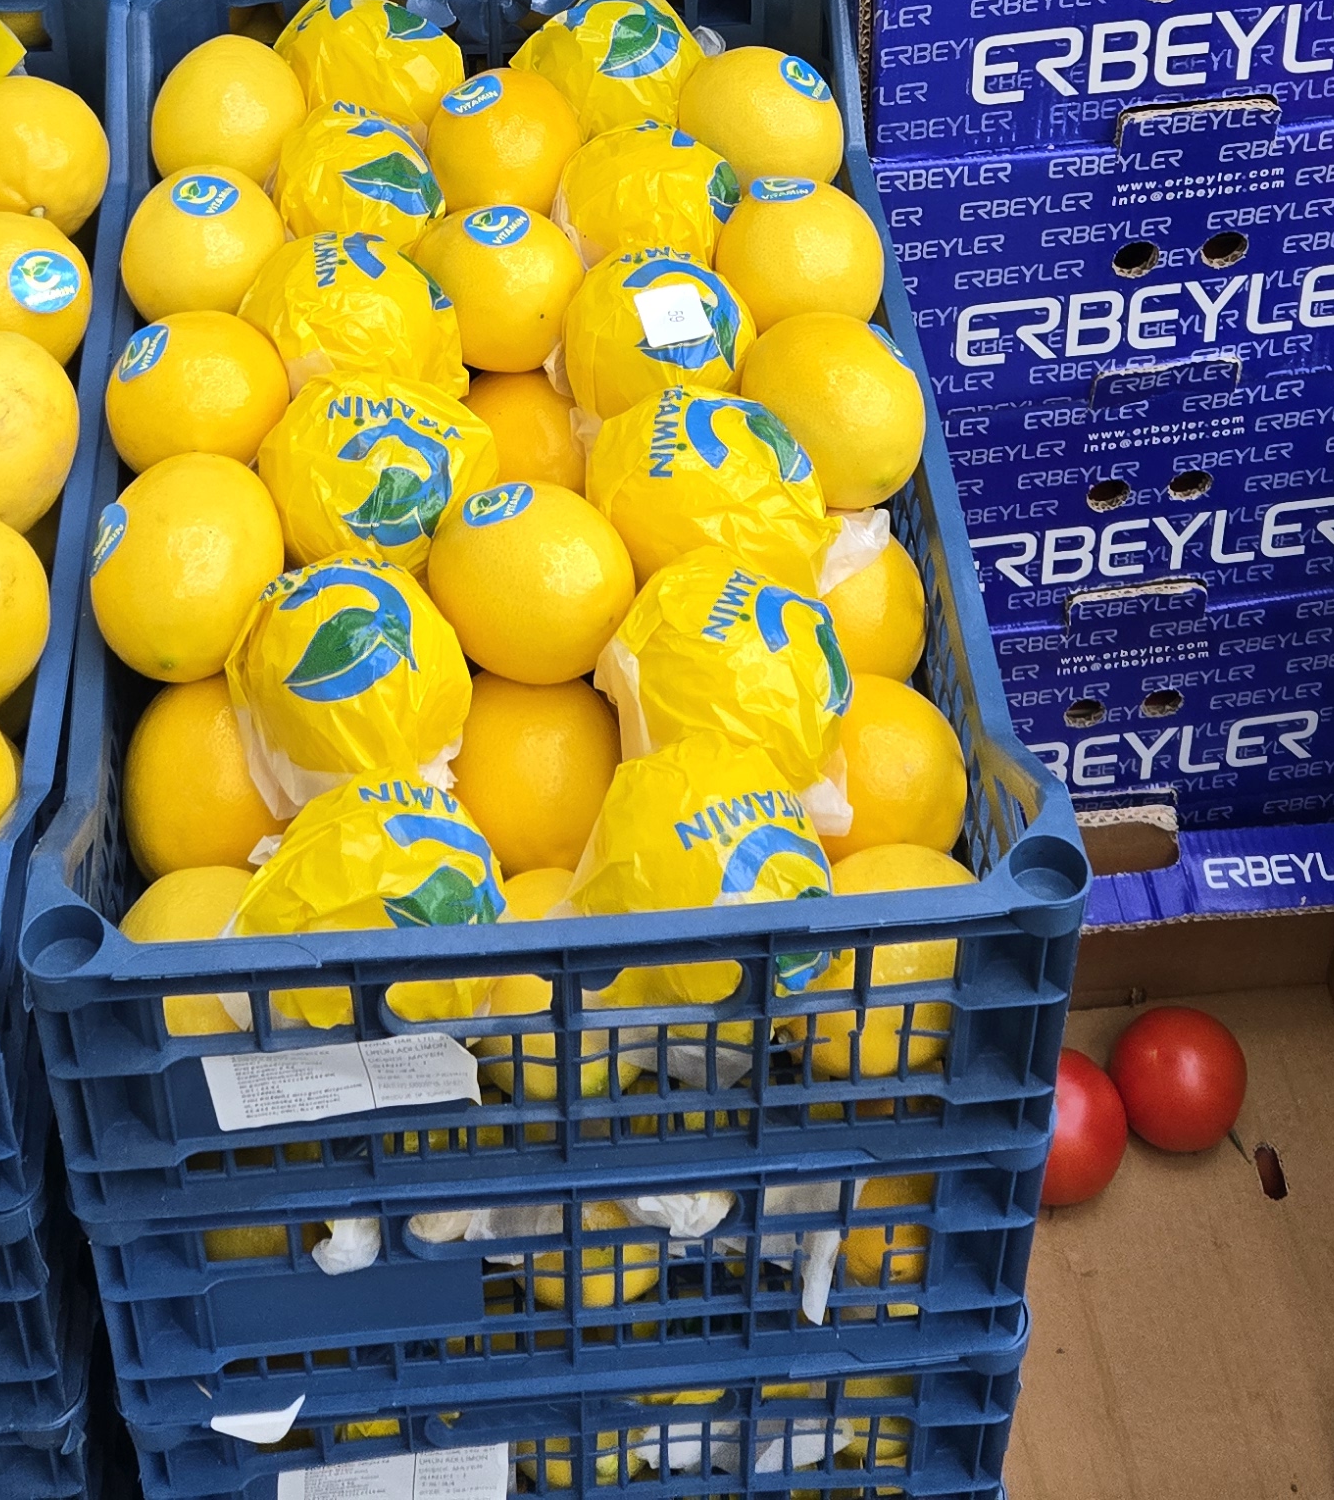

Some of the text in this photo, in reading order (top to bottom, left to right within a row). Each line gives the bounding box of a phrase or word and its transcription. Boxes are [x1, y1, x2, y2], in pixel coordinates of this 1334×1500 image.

[1049, 149, 1183, 179] ERBEYLER
[1117, 165, 1284, 192] www.erbeyler.com
[960, 192, 1093, 221] ERBEYLER
[1112, 179, 1284, 207] info@erbeyler.com
[954, 260, 1084, 289] ERBEYLER
[1084, 427, 1245, 452] info@erbeyler.com
[1088, 416, 1244, 441] www.erbeyler.com
